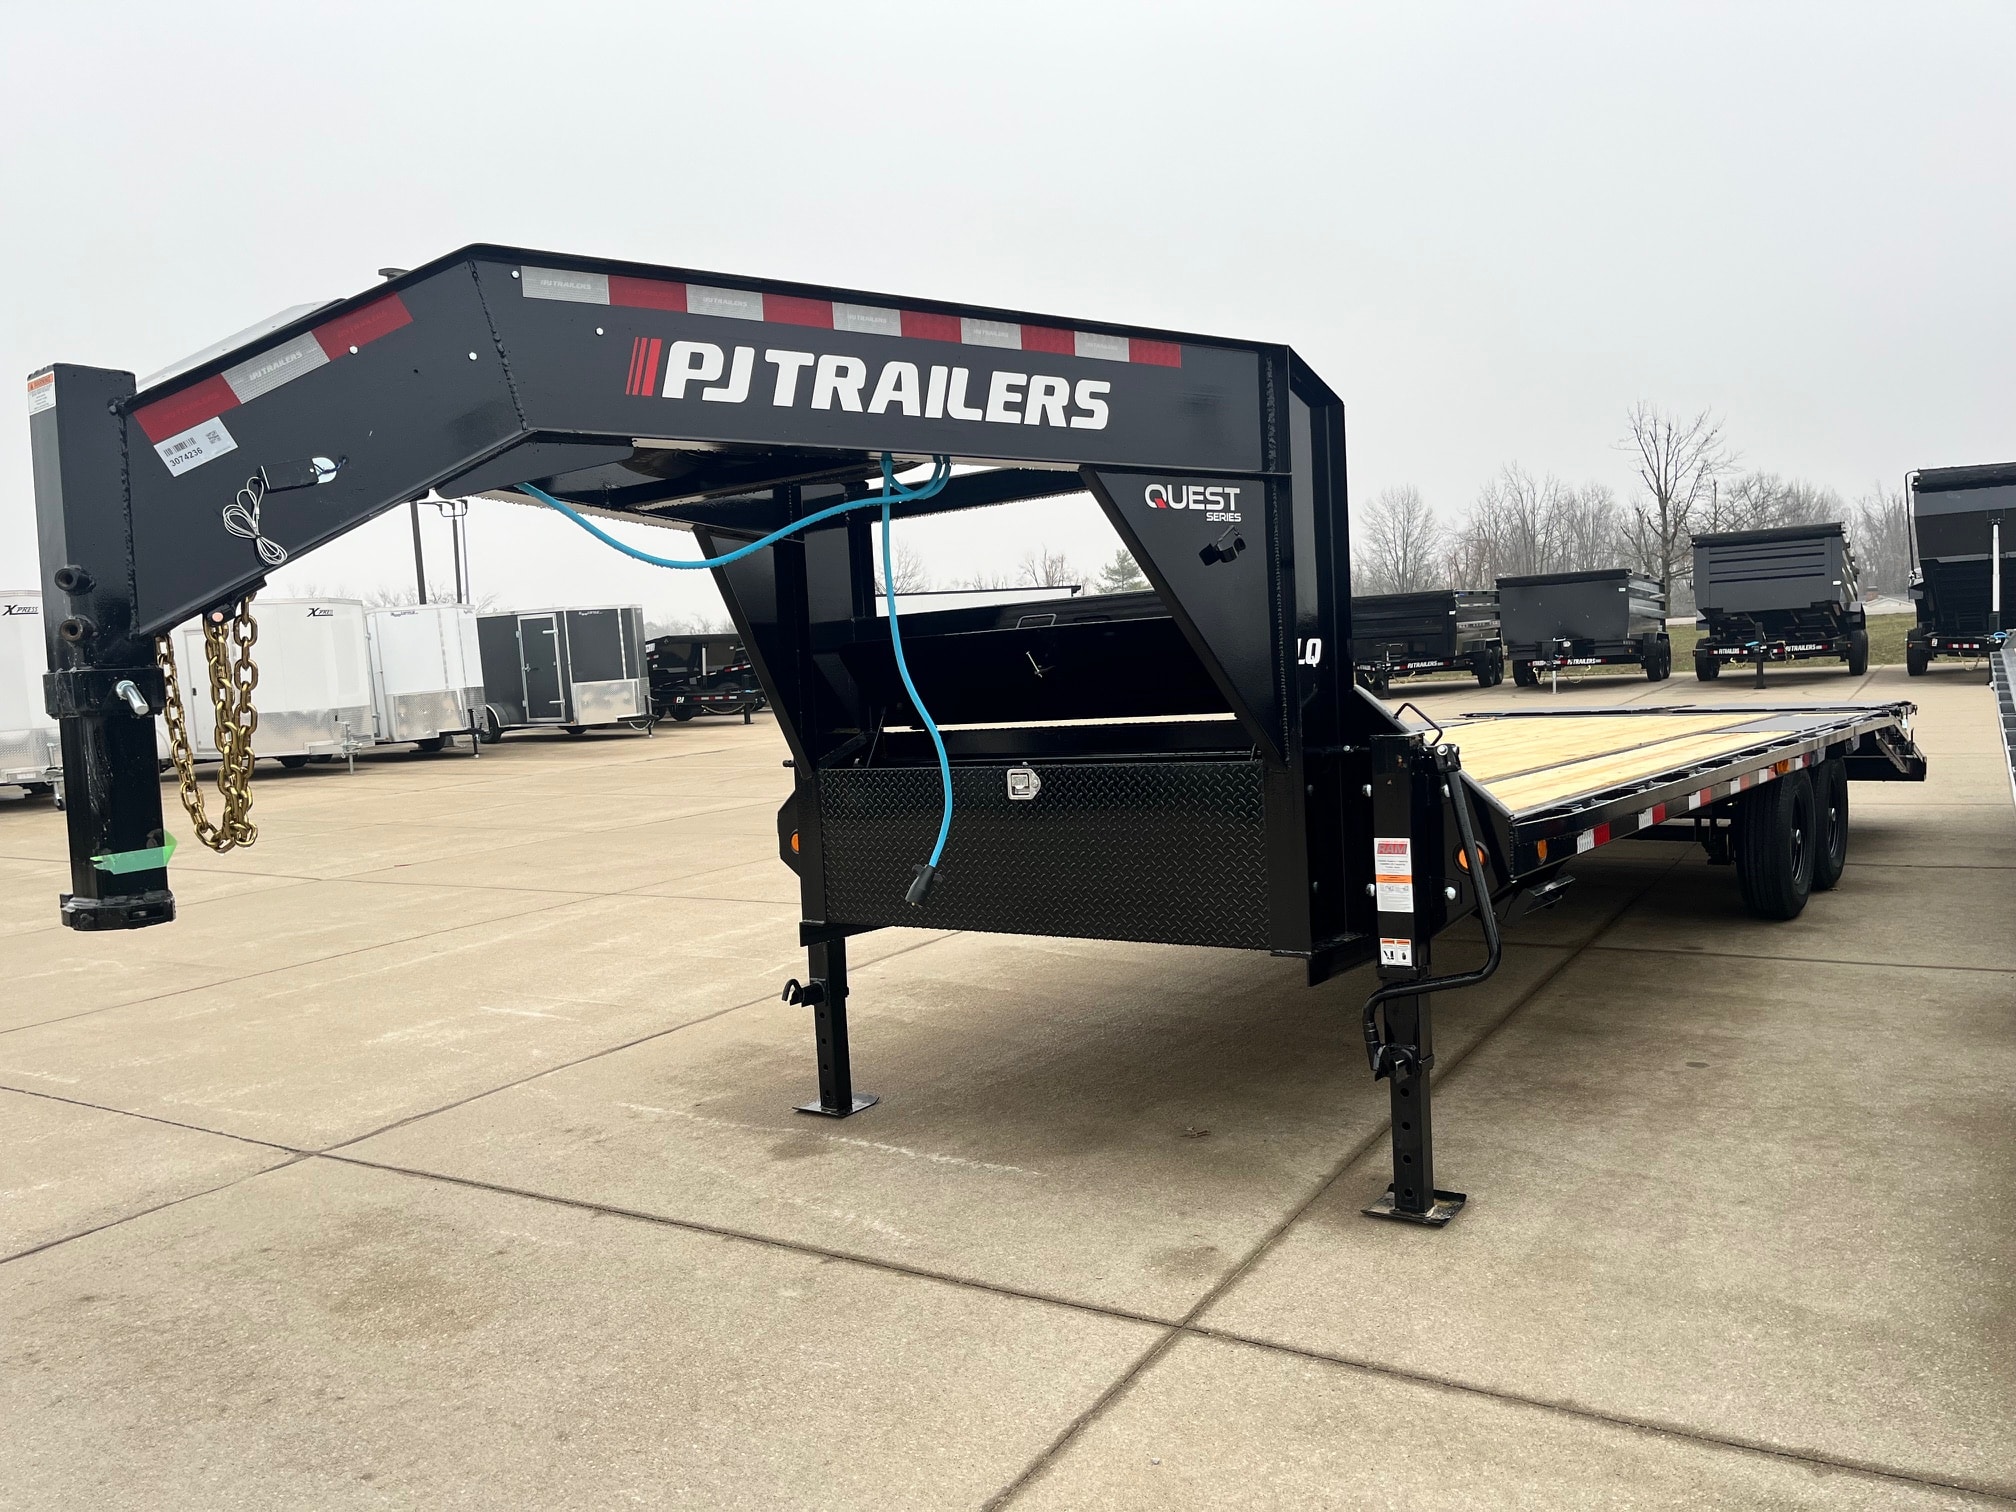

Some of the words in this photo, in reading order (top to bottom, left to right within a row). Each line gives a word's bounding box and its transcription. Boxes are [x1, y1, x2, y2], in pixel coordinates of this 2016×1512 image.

[765, 348, 1111, 430] TRAILERS
[169, 447, 203, 467] 3074236
[1144, 483, 1240, 511] QUEST
[1206, 512, 1242, 522] SERIES
